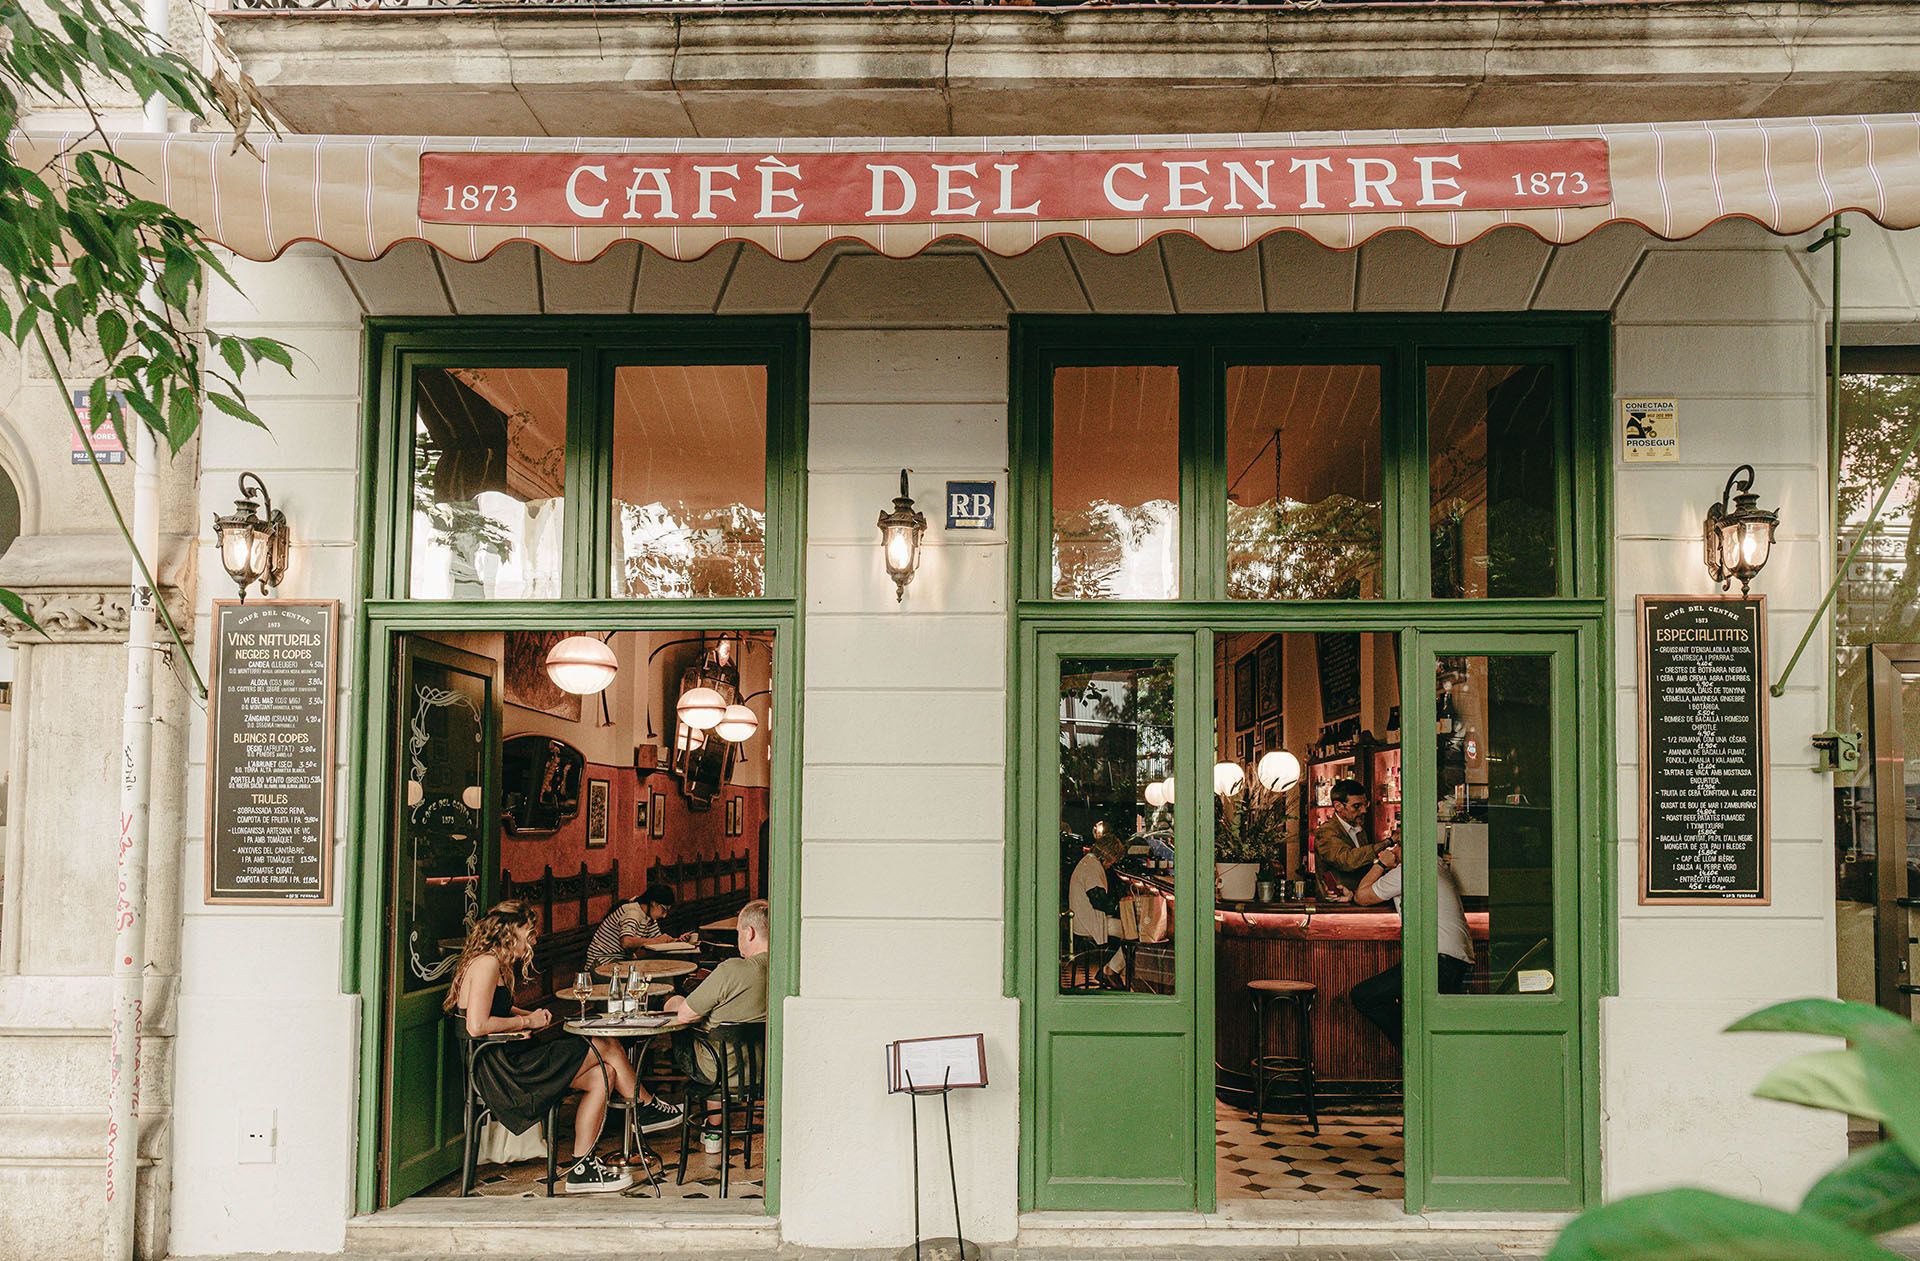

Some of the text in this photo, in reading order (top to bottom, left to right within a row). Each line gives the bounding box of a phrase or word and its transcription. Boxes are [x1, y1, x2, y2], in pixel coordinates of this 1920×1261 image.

[442, 184, 518, 212] 1873
[866, 163, 1041, 217] DEL
[1103, 153, 1468, 213] CENTRE
[1511, 171, 1590, 197] 1873
[950, 493, 992, 518] RB
[281, 611, 311, 625] CENTRE
[1708, 607, 1740, 620] CENTRE
[228, 632, 321, 646] VINS NATURALS
[1656, 629, 1749, 641] ESPECIALITATS
[235, 649, 312, 660] NEGRES A COPES
[1664, 666, 1688, 674] CRESTES
[1690, 666, 1698, 674] DE
[233, 732, 310, 744] BLANCS A COPES
[251, 793, 289, 804] TAULES
[235, 876, 260, 884] COMPOTA
